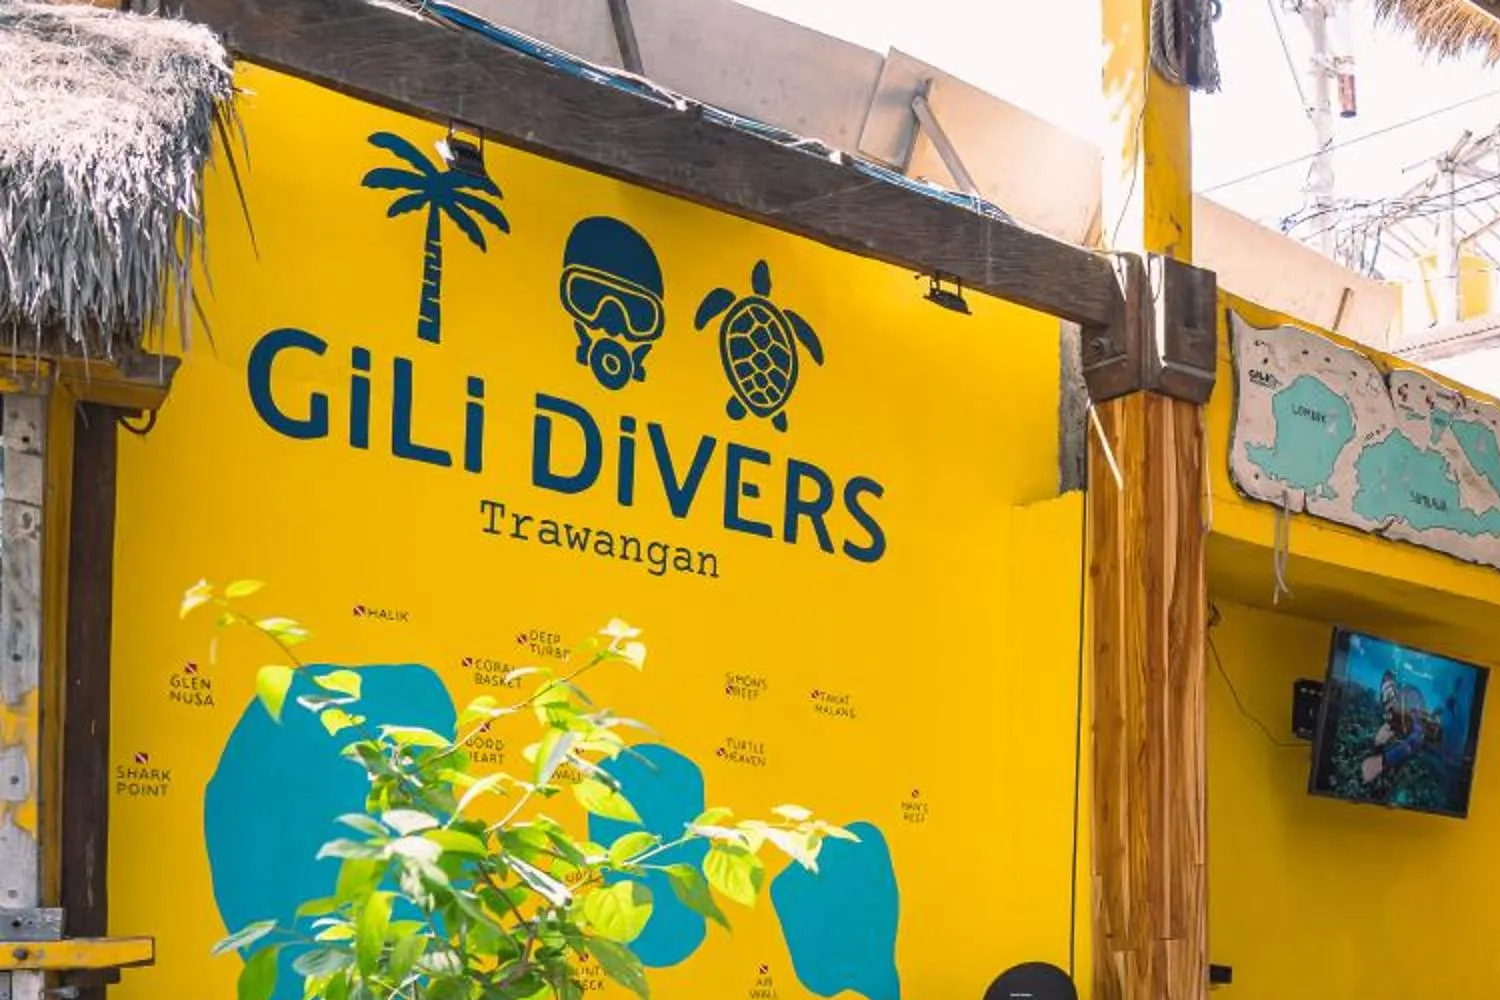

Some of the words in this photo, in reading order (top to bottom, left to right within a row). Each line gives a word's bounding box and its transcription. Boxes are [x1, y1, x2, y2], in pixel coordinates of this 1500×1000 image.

[480, 499, 720, 578] Trawangan
[367, 608, 409, 623] HALIK
[529, 630, 561, 644] DEEP
[169, 673, 211, 690] GLEN
[475, 674, 522, 688] BASKET
[169, 691, 214, 707] NUSA
[733, 686, 759, 700] REEF
[726, 737, 764, 754] TURTLE
[725, 752, 766, 766] HEAVEN
[116, 766, 171, 782] SHARK
[116, 781, 169, 797] POINT
[750, 989, 778, 1000] WALL
